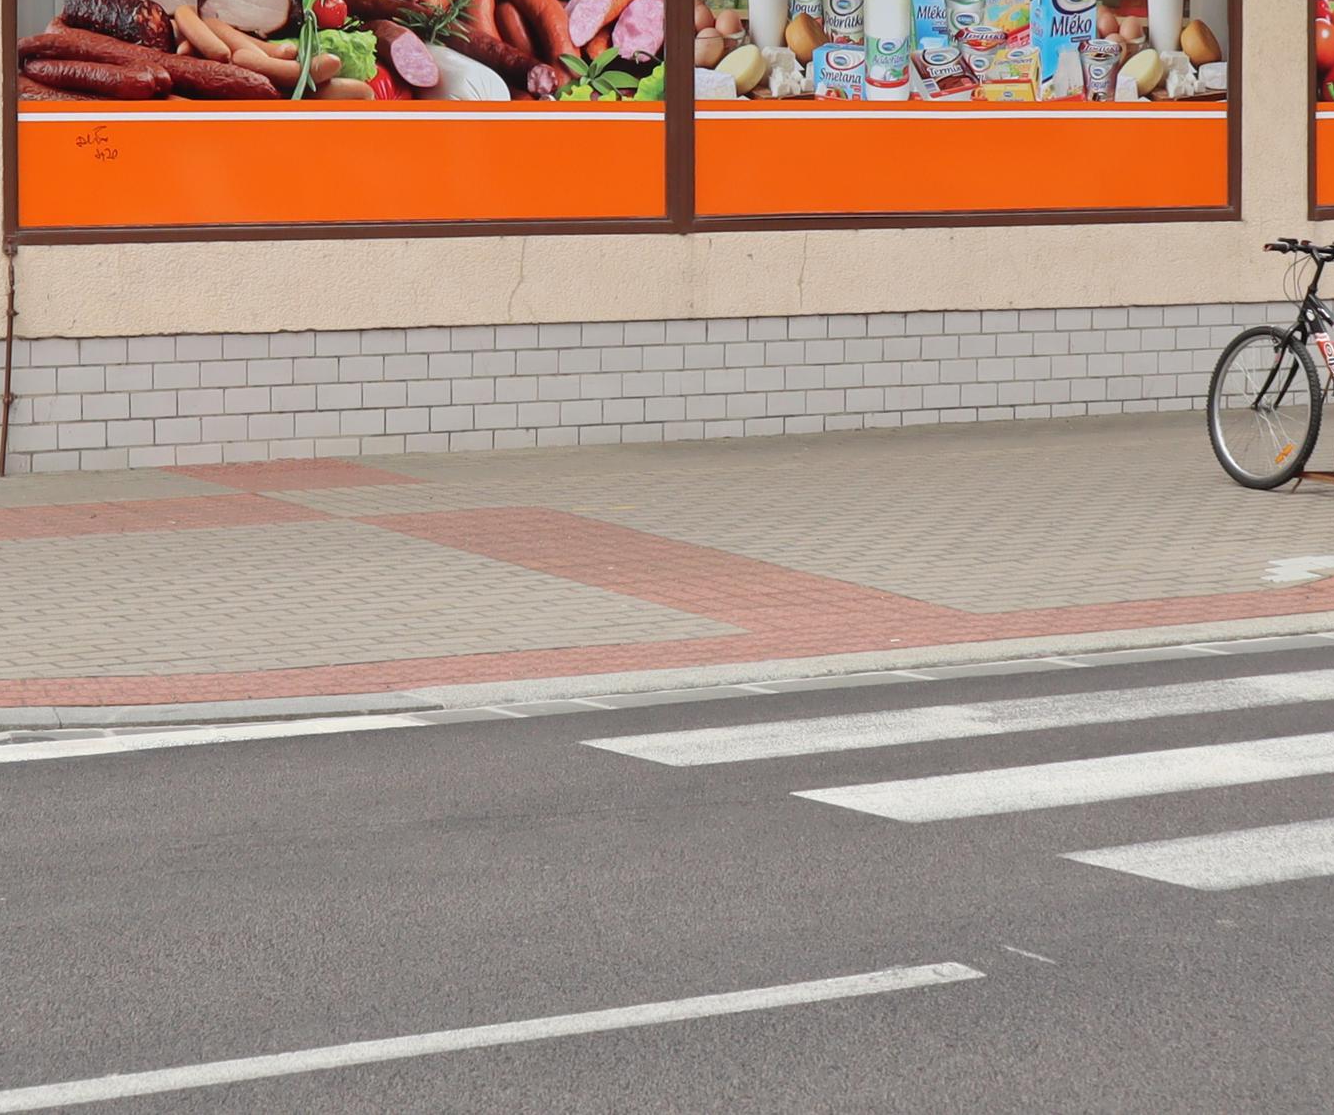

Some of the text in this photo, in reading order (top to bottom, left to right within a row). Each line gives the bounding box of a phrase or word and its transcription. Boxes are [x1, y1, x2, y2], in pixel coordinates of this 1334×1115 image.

[917, 4, 947, 20] Mléko
[1050, 14, 1092, 38] Mléko
[819, 68, 862, 84] Smetana
